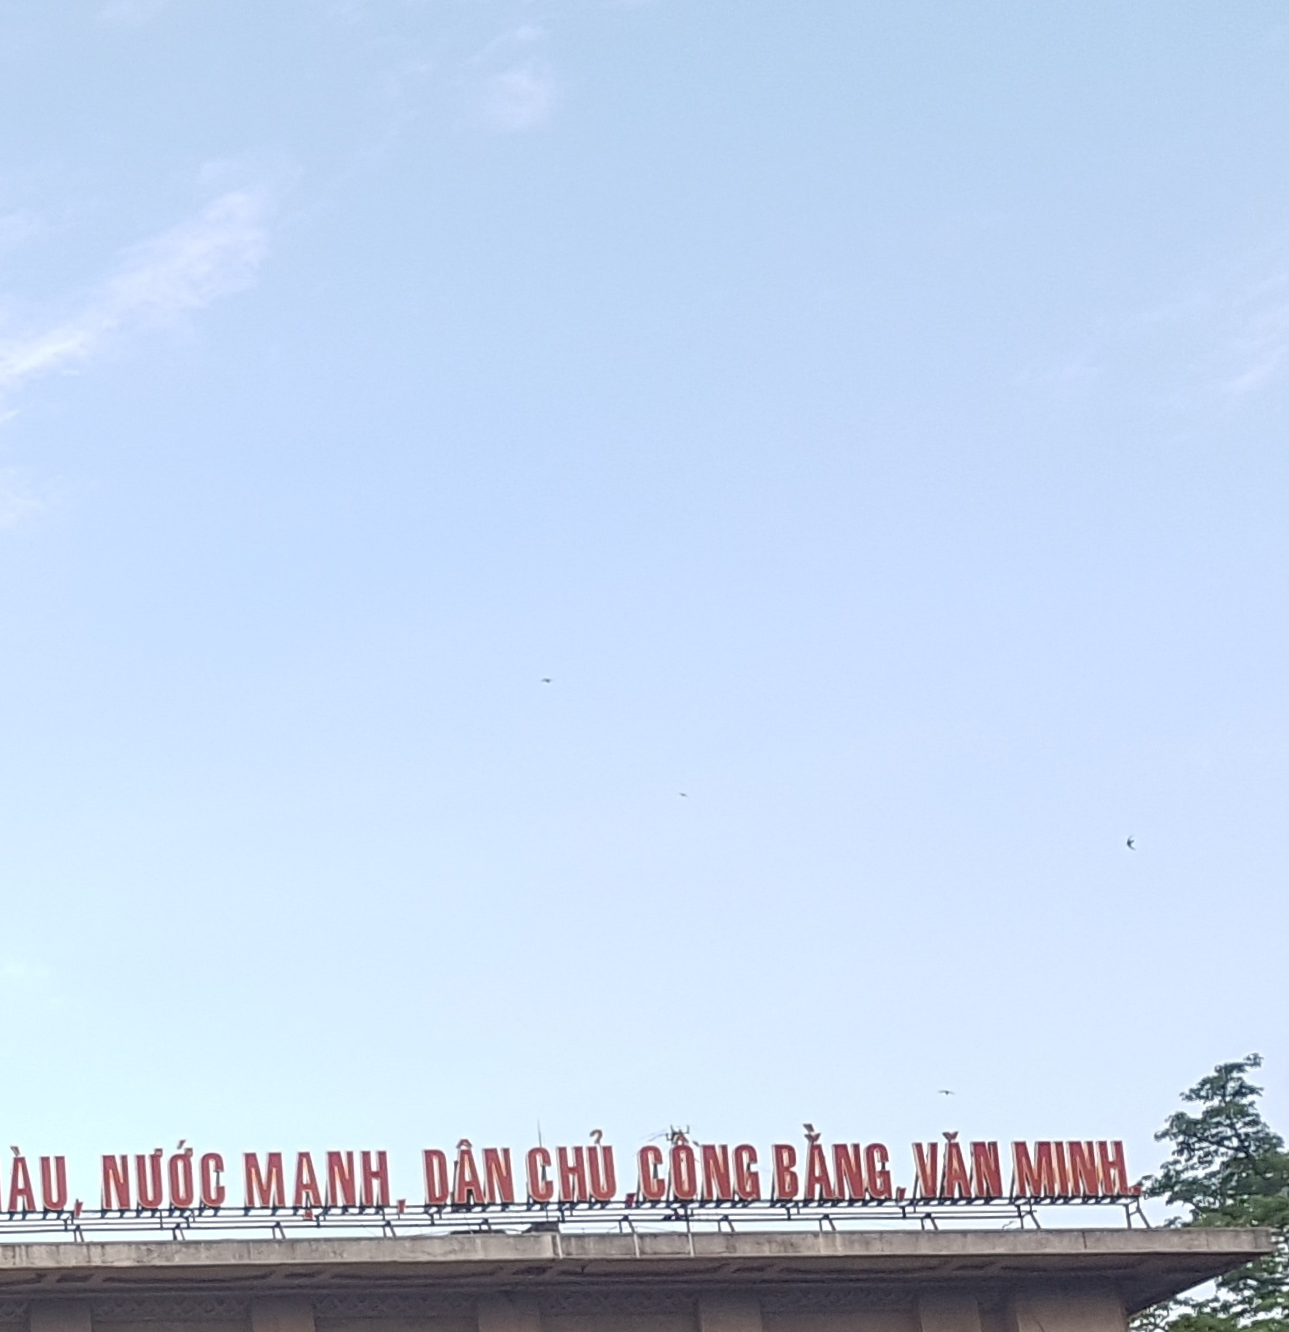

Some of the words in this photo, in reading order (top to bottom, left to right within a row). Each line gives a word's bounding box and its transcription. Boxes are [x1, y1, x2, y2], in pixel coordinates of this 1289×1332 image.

[101, 1140, 226, 1210] NƯỚC
[423, 1138, 515, 1205] DÂN
[638, 1133, 761, 1200] CÔNG
[913, 1131, 1000, 1197] VĂN
